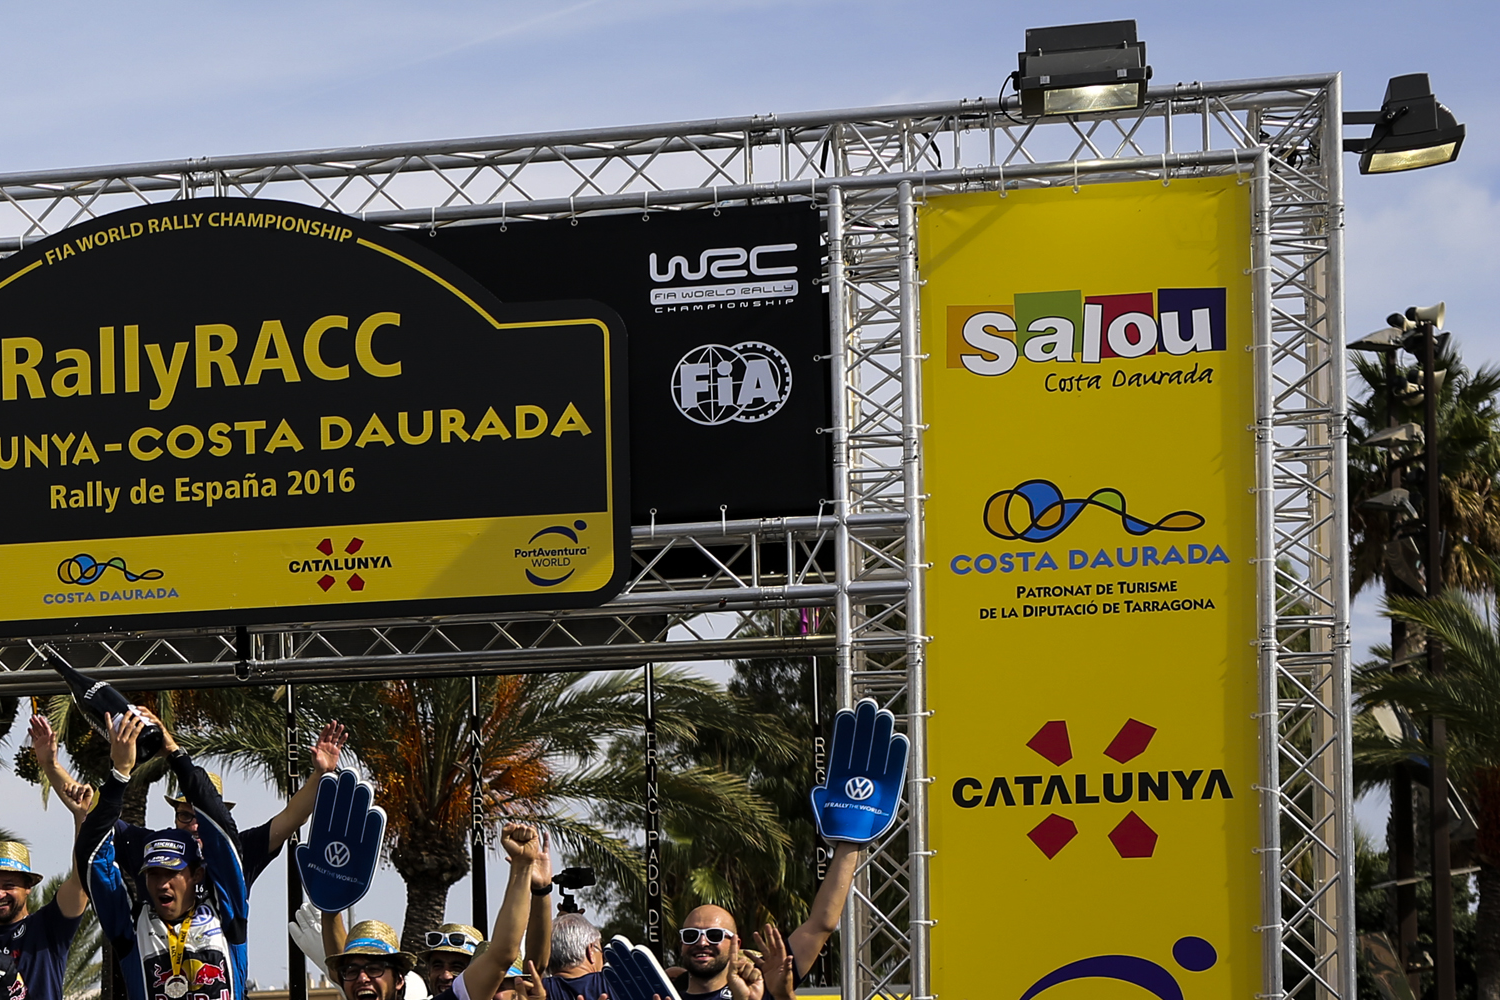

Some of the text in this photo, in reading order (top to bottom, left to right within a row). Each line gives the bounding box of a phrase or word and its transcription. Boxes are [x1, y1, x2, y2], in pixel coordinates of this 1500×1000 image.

[44, 211, 353, 266] FIA WORLD RALLY CHAMPIONSHIP
[649, 243, 798, 283] WRC
[653, 283, 793, 302] FIA WORLD RALLY
[654, 299, 795, 315] CHAMPIONSHIP
[1, 311, 402, 411] RallyRACC
[1044, 363, 1214, 393] Costa Daurada
[319, 401, 592, 452] DAURADA
[50, 467, 356, 514] Rally de España 2016
[288, 555, 392, 574] CATALUNYA
[531, 557, 571, 569] WORLD
[950, 543, 1231, 575] COSTA DAURADA
[43, 587, 179, 606] COSTA DAURADA
[1016, 580, 1178, 600] PATRONAT DE TURISME
[979, 607, 998, 620] DE
[1001, 606, 1019, 619] LA
[1102, 602, 1121, 614] DE
[1124, 598, 1215, 614] TARRAGONA
[951, 768, 1234, 809] CATALUNYA
